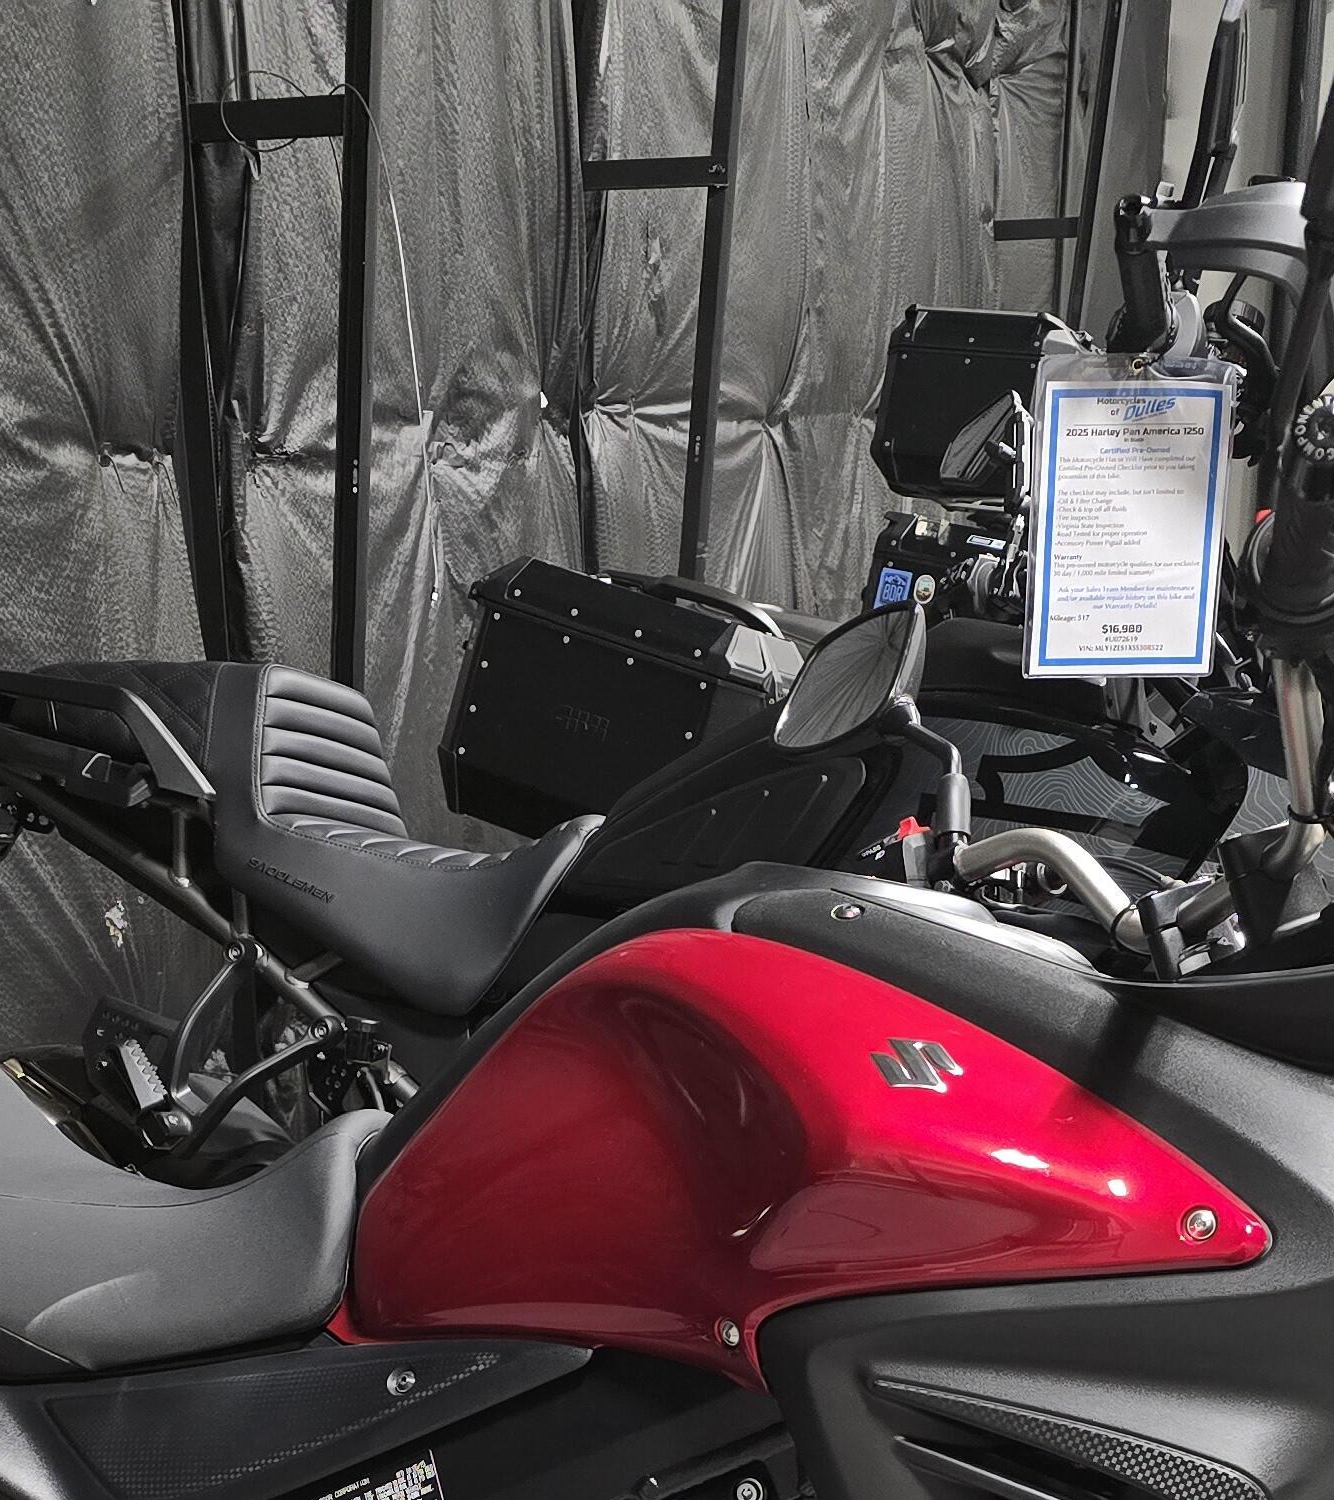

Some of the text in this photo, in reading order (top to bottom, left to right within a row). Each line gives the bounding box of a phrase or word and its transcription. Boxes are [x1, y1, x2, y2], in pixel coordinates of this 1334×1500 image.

[1097, 397, 1146, 406] Motorcycles
[1123, 397, 1176, 421] Dulles
[1066, 427, 1204, 438] 2025 Harley Pan America 1250
[882, 583, 903, 601] BDR
